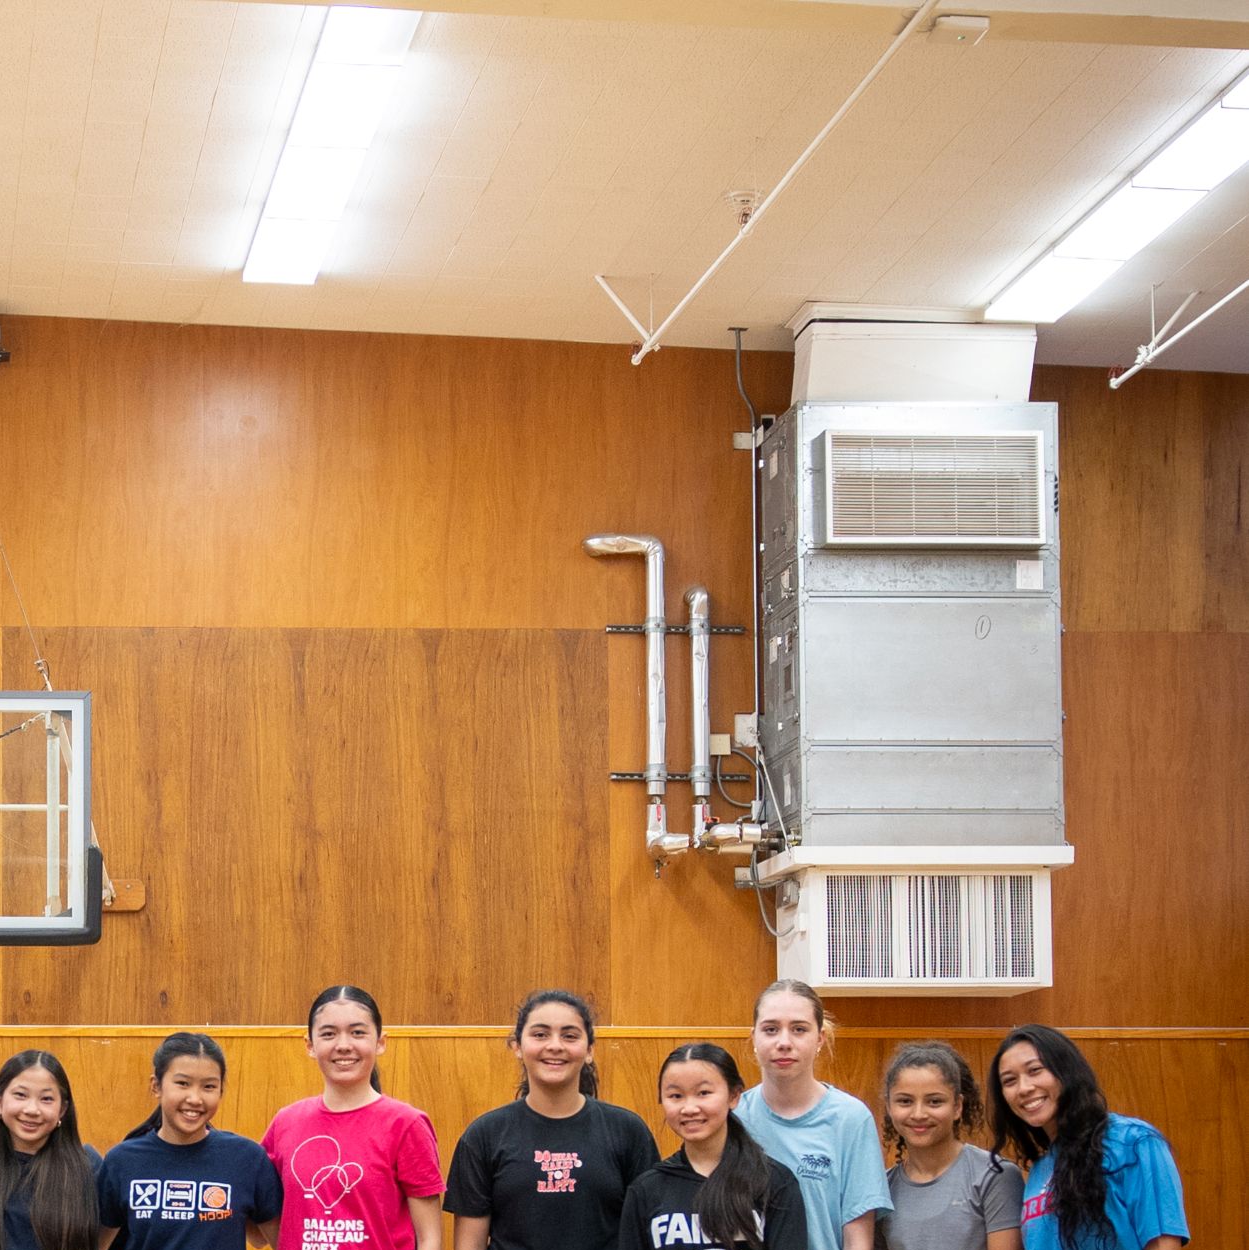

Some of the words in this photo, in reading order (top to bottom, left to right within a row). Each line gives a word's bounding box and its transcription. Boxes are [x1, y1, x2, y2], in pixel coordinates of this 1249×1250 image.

[533, 1150, 551, 1163] DO
[537, 1178, 577, 1193] HAPPY
[135, 1210, 153, 1219] EAT
[161, 1210, 195, 1221] SLEEP
[303, 1218, 365, 1231] BALLONS
